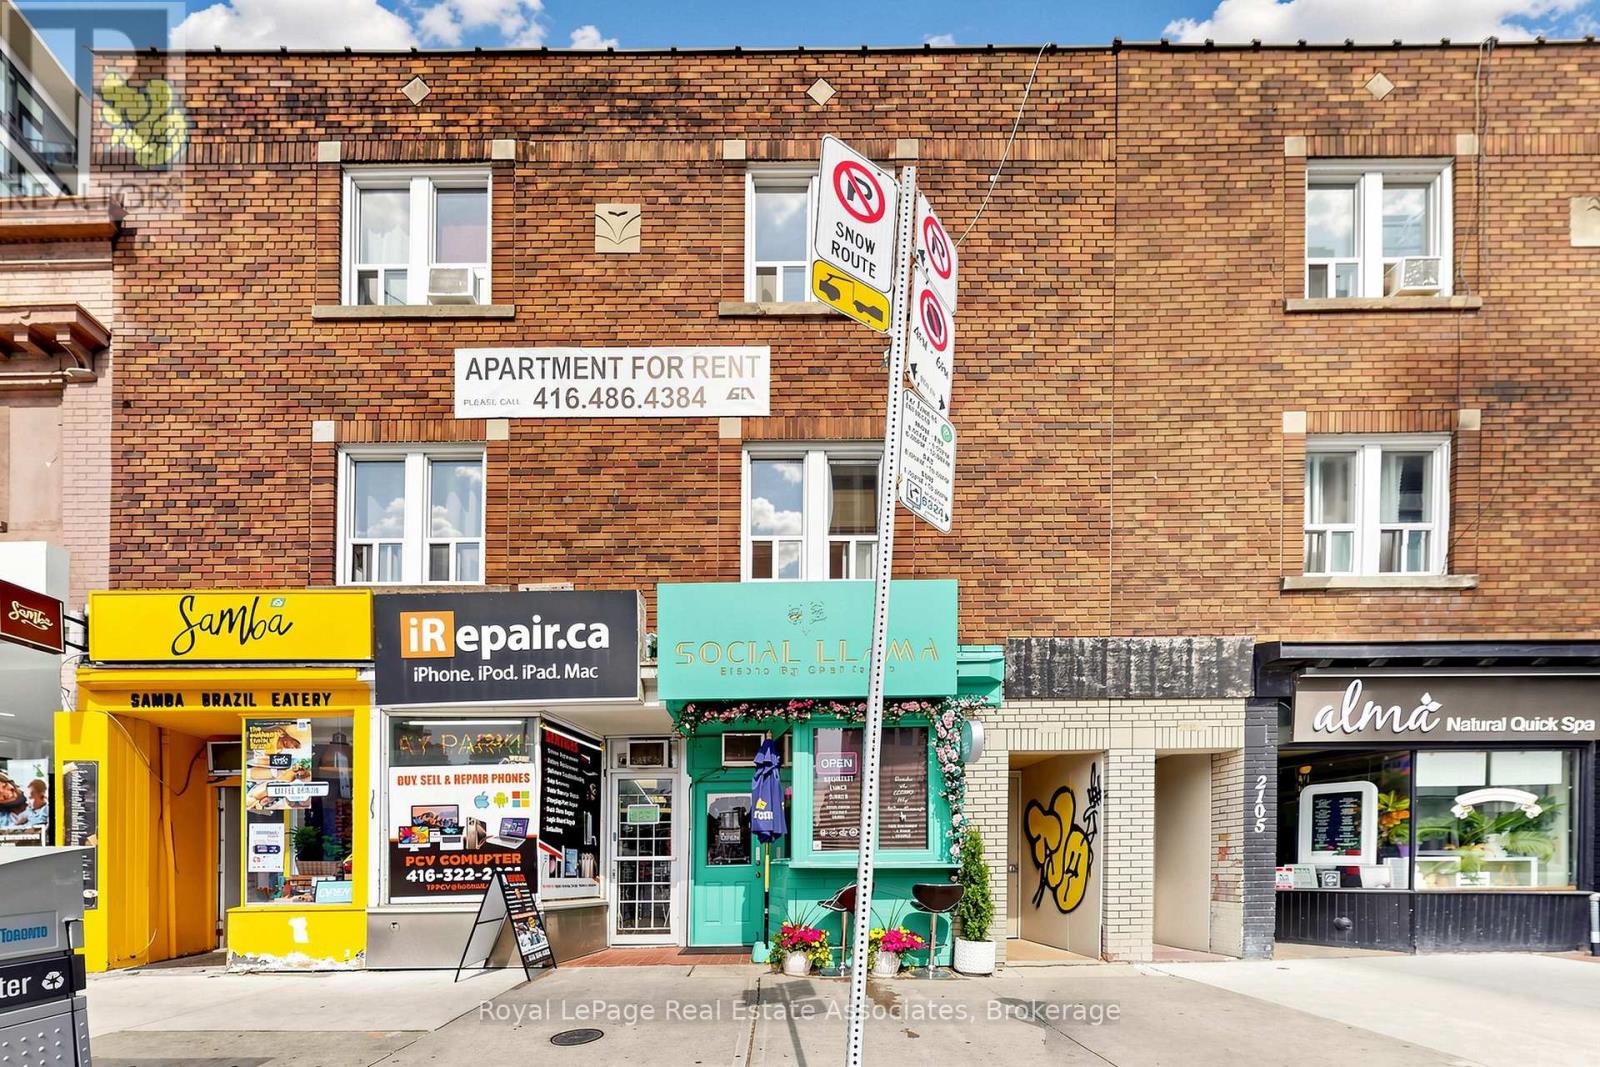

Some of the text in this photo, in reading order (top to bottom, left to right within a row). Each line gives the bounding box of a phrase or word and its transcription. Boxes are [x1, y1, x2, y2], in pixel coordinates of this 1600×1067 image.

[835, 221, 876, 255] SNOW
[831, 240, 877, 279] ROUTE
[465, 354, 761, 381] APARTMENT FOR RENT
[533, 386, 706, 409] 416.486.4384
[171, 595, 293, 656] Samba
[408, 614, 610, 660] iRepair.ca
[675, 640, 801, 665] SOCIAL
[413, 663, 599, 683] iPhone. iPod. iPad. Mac
[131, 692, 332, 708] SAMBA BRAZIL EATERY
[1312, 678, 1595, 735] alma Natural Quick Spa
[821, 759, 853, 769] OPEN
[397, 775, 418, 786] BUY
[420, 775, 442, 785] SELL
[453, 774, 489, 785] REPAIR
[491, 773, 530, 784] PHONES
[1253, 775, 1268, 834] 2105
[405, 853, 521, 867] PCV COMUPTER
[406, 867, 521, 883] 416-322-2
[0, 926, 48, 943] TORONTO
